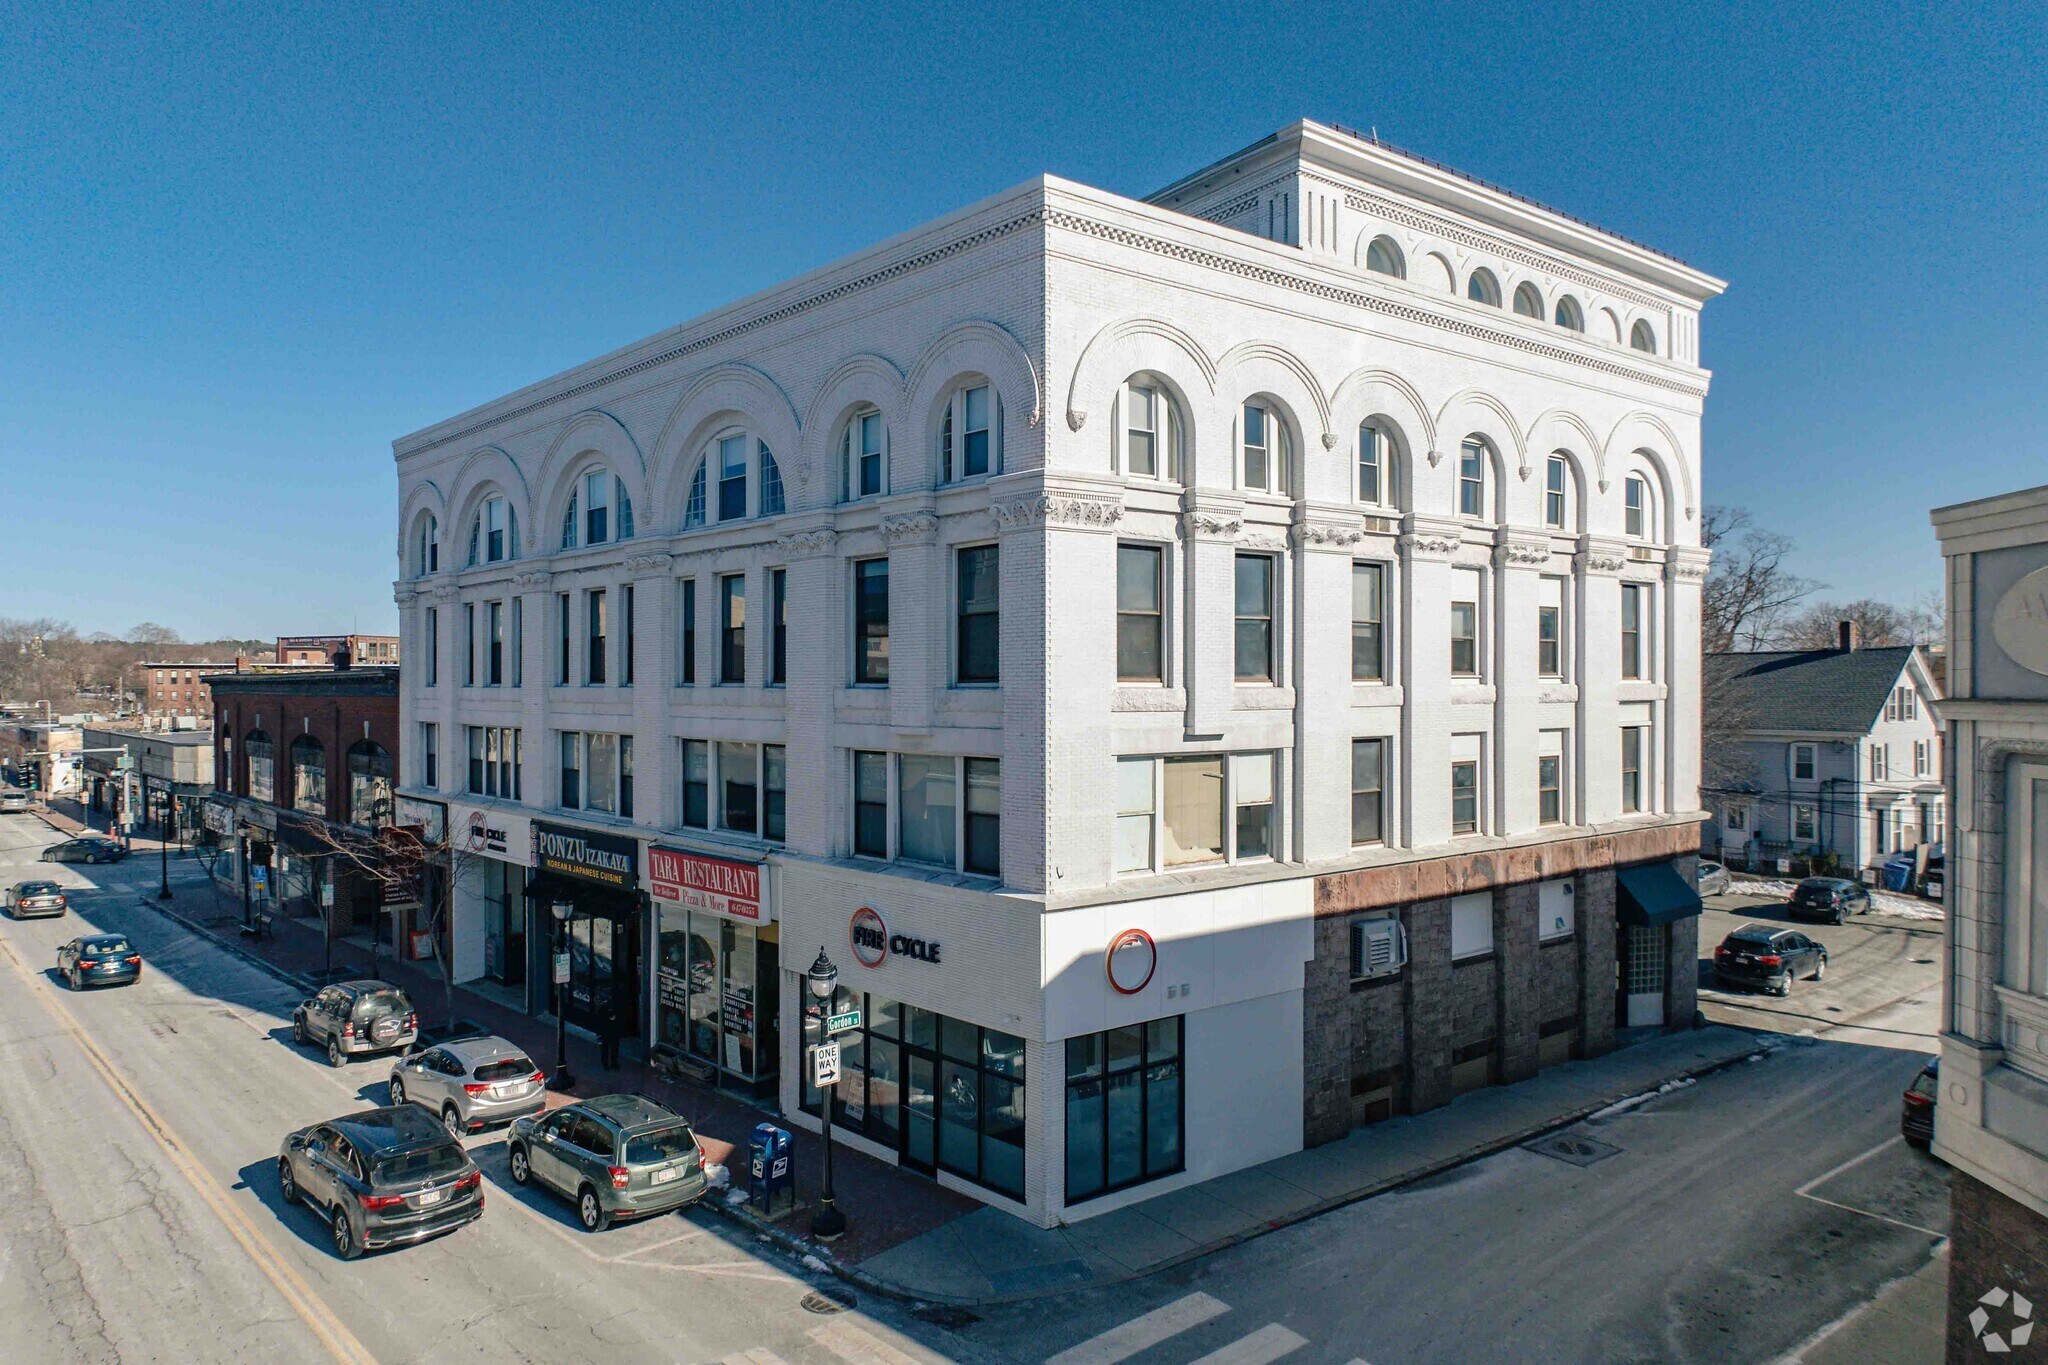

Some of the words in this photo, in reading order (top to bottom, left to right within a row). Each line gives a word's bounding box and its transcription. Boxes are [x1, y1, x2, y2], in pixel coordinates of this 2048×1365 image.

[539, 831, 587, 863] PONZU
[586, 848, 629, 872] IZAKAYA
[547, 859, 567, 871] KOREAN
[573, 865, 599, 879] JAPANESE
[600, 871, 622, 884] CUISINE
[652, 853, 679, 882] TARA
[683, 859, 756, 898] RESTAURANT
[682, 889, 698, 906] Pizza
[701, 893, 707, 908] &
[709, 895, 725, 912] More
[853, 926, 884, 950] FIRE
[890, 934, 941, 963] CYCLE
[830, 1017, 851, 1030] Gordon
[819, 1047, 836, 1059] ONE
[819, 1058, 837, 1070] WAY
